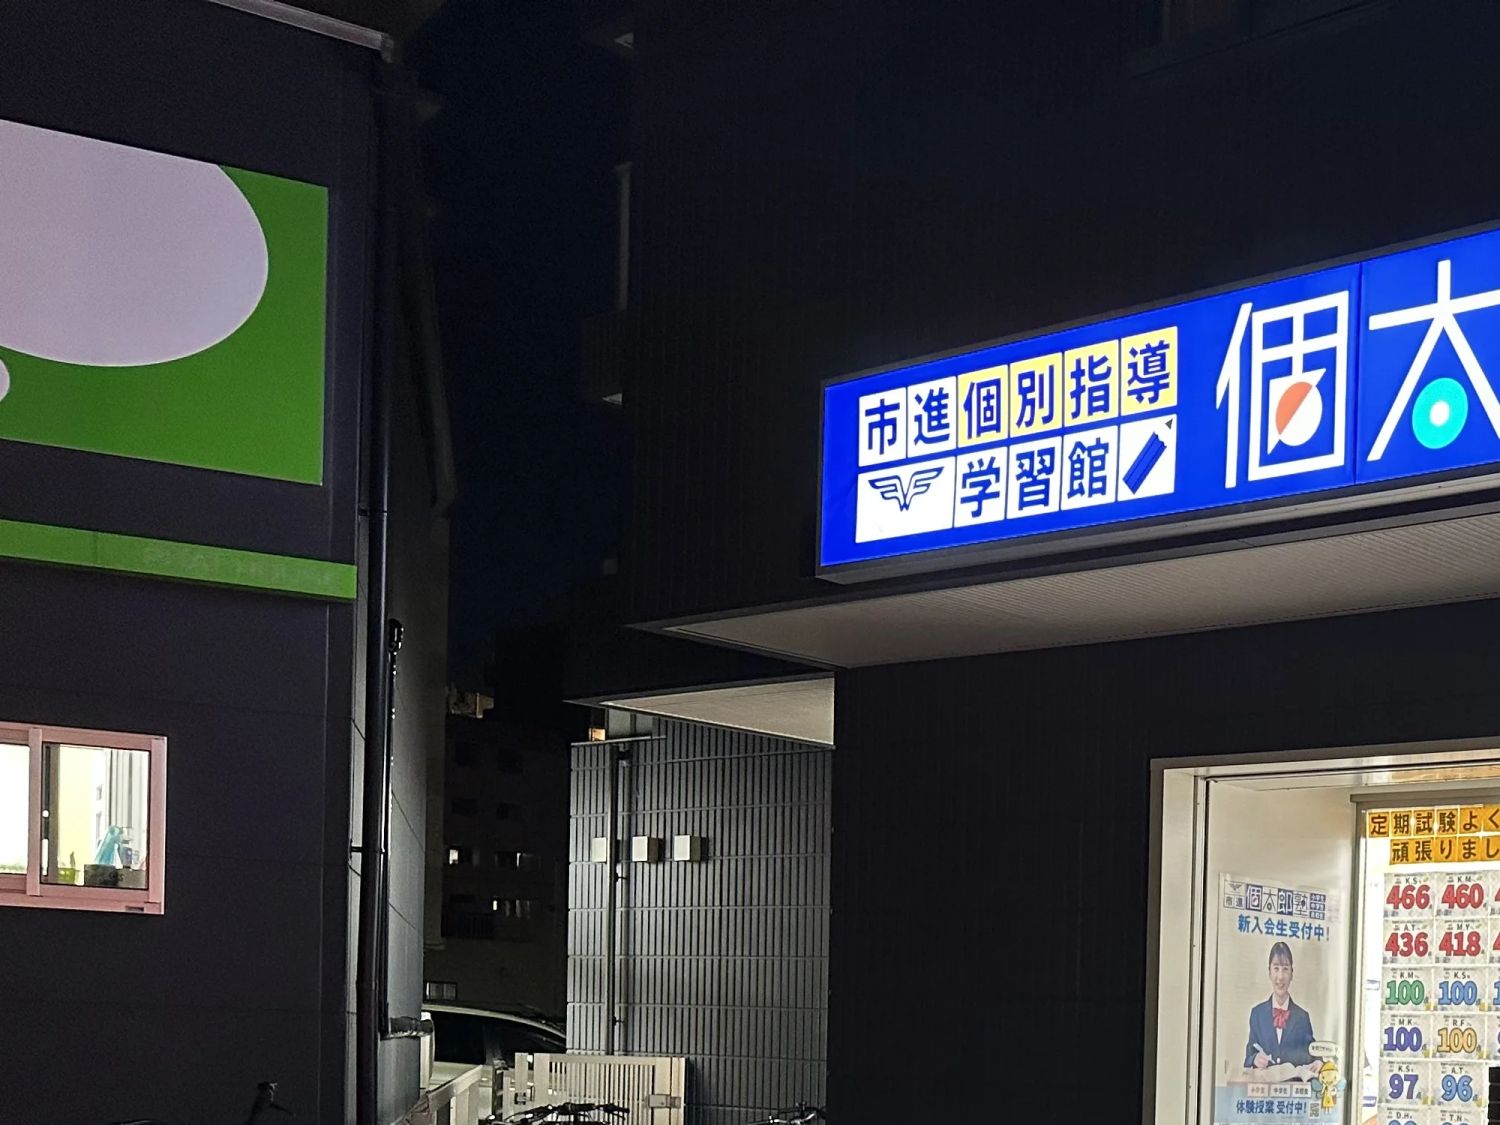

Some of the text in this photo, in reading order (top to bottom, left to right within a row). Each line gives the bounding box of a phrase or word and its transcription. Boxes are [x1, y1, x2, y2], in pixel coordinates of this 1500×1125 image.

[864, 340, 1170, 455] 市進個別指導
[960, 437, 1110, 518] 学習館
[1386, 884, 1430, 910] 466
[1441, 883, 1484, 910] 460
[1385, 932, 1428, 957] 436
[1438, 930, 1481, 957] 418
[1385, 980, 1425, 1006] 100
[1438, 980, 1478, 1006] 100
[1384, 1026, 1422, 1052] 100
[1437, 1028, 1478, 1054] 100
[1388, 1074, 1418, 1100] 97
[1441, 1074, 1473, 1102] 96
